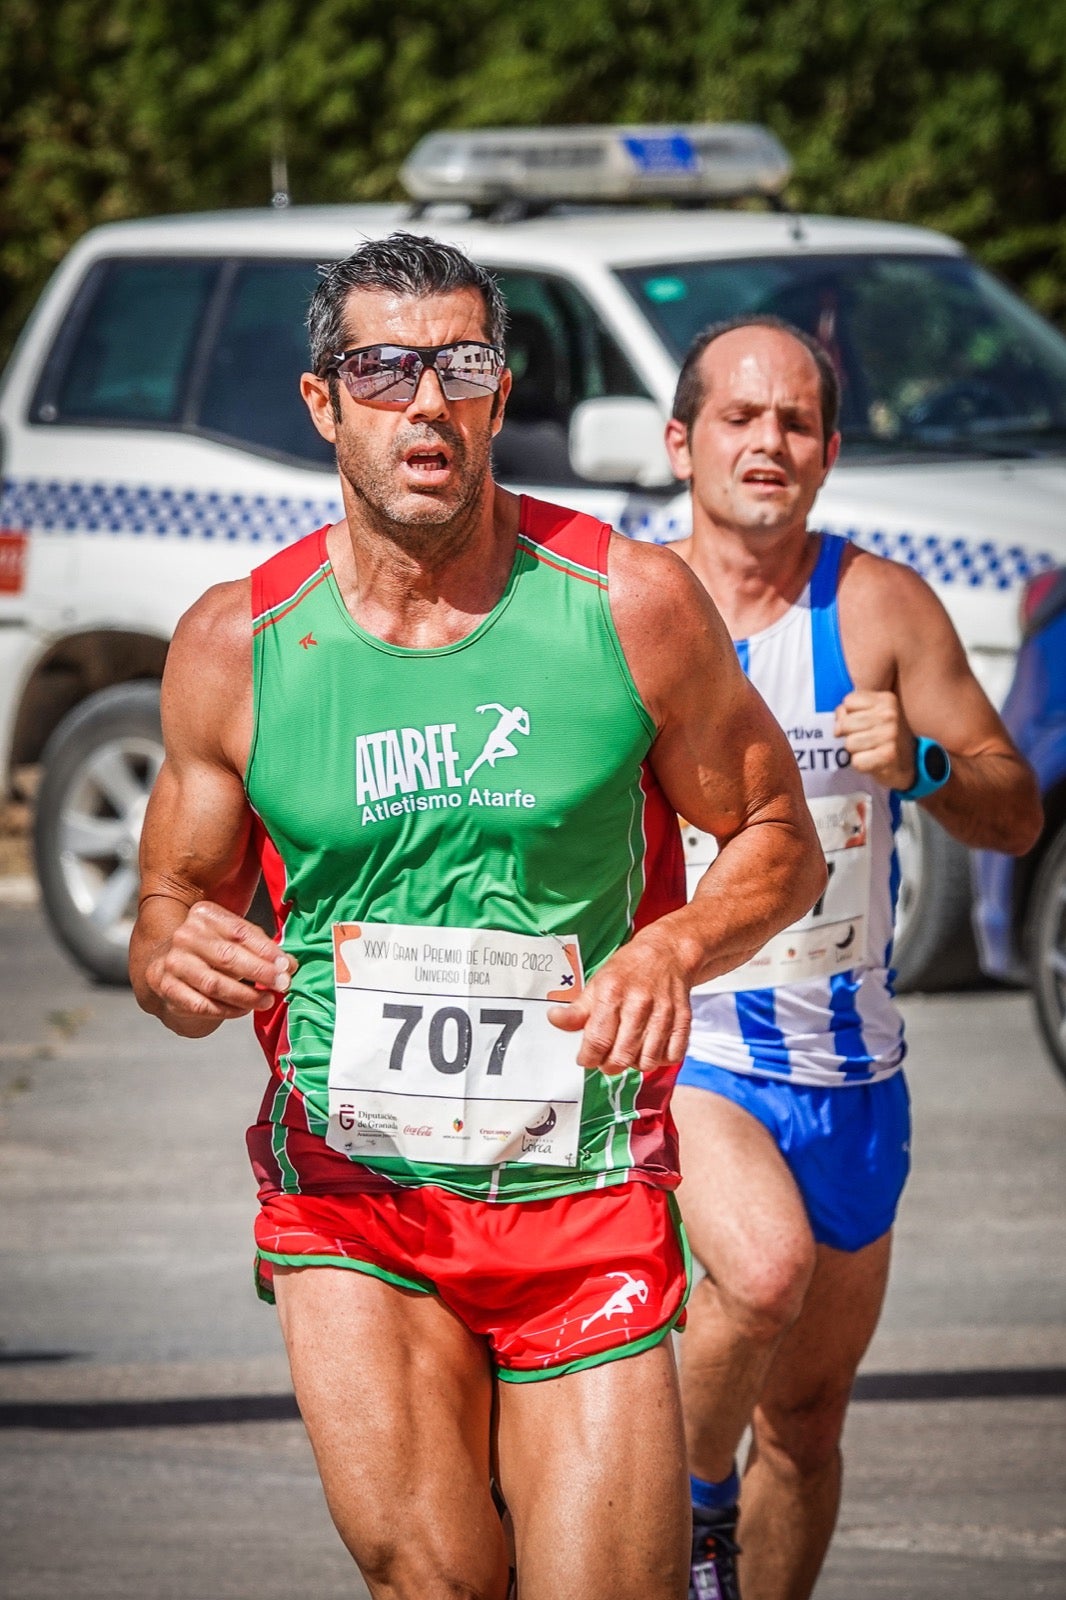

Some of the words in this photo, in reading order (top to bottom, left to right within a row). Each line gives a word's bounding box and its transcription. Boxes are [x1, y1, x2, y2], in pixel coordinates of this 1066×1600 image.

[356, 723, 463, 806] ATARFE
[361, 793, 462, 827] Atletismo
[468, 788, 536, 808] Atarfe
[363, 940, 391, 959] XXXV
[521, 952, 554, 972] 2022
[382, 1003, 524, 1076] 707
